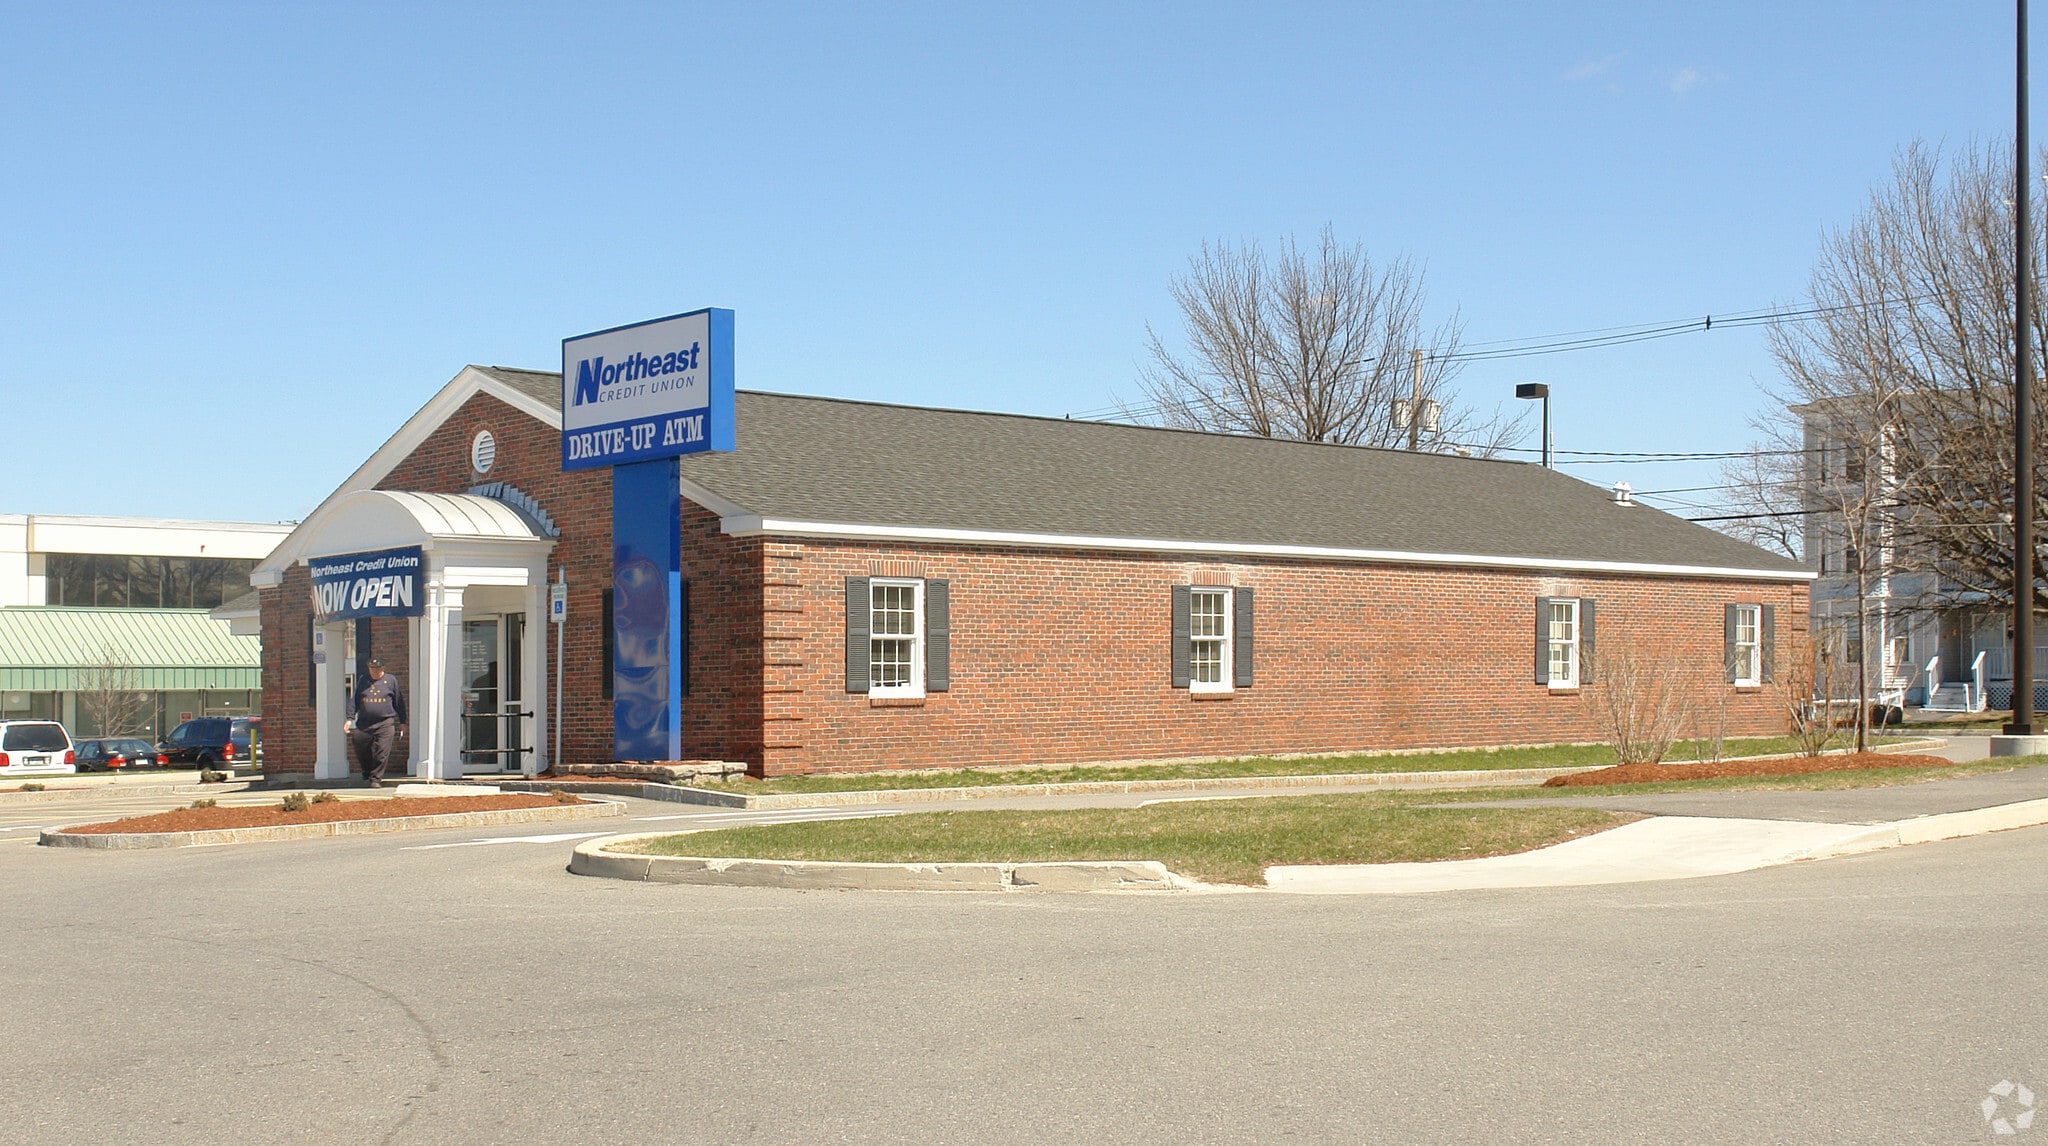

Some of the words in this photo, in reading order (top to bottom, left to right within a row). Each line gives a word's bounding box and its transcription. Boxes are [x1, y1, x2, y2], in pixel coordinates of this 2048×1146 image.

[572, 342, 700, 407] Northeast
[599, 385, 645, 402] CREDIT
[651, 376, 695, 394] UNION
[568, 422, 656, 460] DRIVE-UP
[662, 415, 704, 446] ATM
[311, 562, 354, 578] Northeast
[355, 558, 385, 572] Credit
[387, 556, 418, 569] Union
[312, 580, 350, 617] NOW
[350, 575, 413, 610] OPEN
